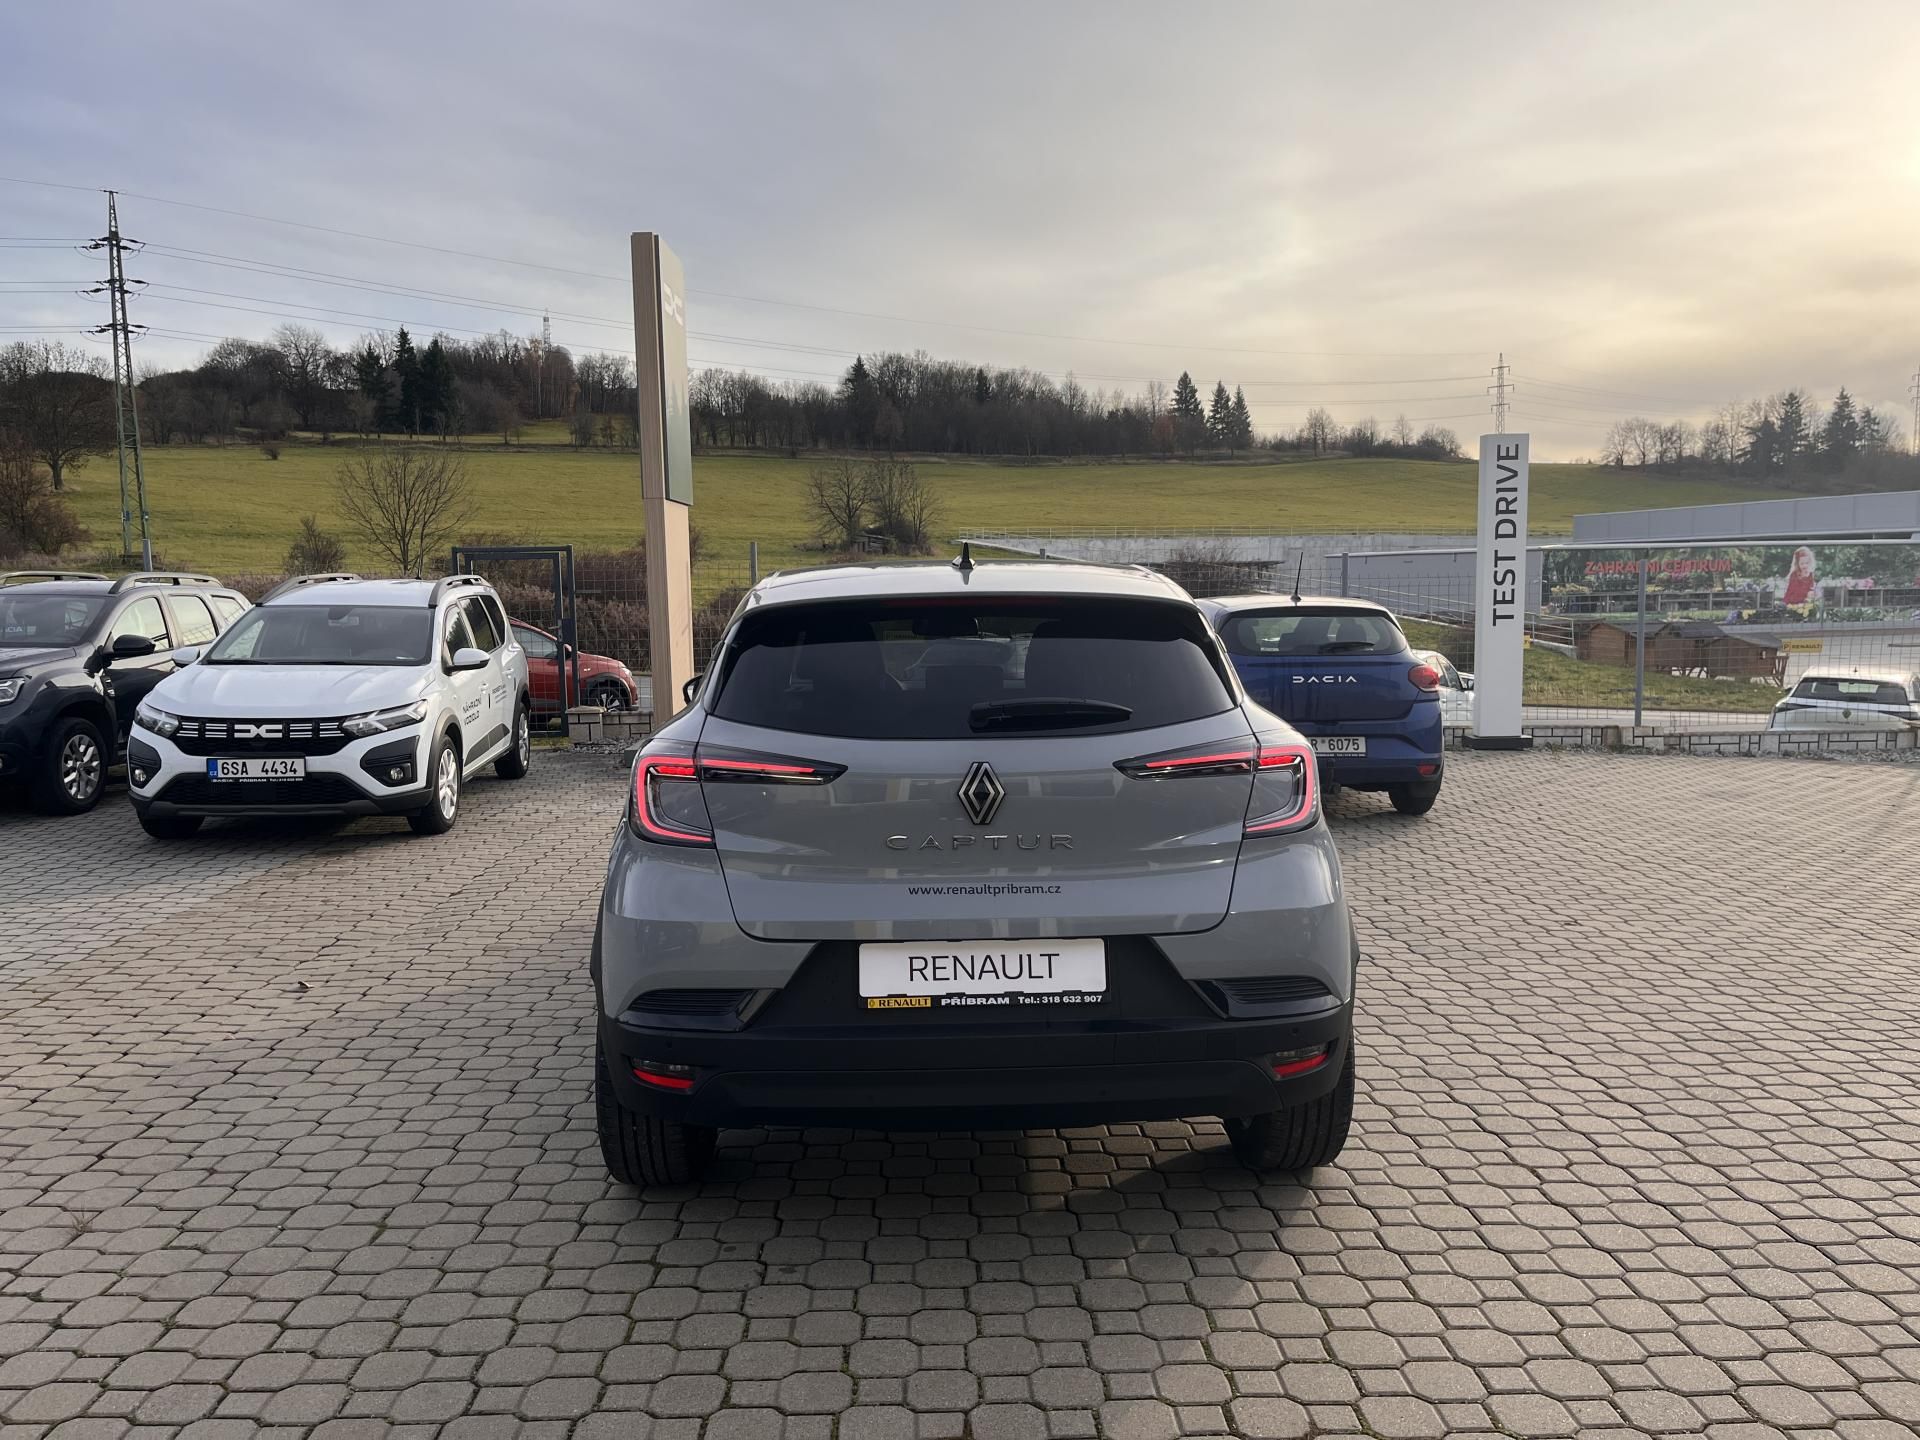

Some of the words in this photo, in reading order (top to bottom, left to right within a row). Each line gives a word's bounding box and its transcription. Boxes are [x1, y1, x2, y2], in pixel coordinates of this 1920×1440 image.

[1494, 443, 1519, 540] DRIVE
[1492, 549, 1516, 627] TEST
[1292, 675, 1357, 683] DACIA
[1328, 738, 1360, 751] 6075
[221, 761, 248, 775] 6SA
[261, 760, 297, 775] 4434
[886, 833, 1074, 850] CAPTUR
[908, 883, 1062, 897] www.renaultpribram.cz
[908, 953, 1060, 982] RENAULT
[878, 998, 930, 1008] RENAULT
[941, 996, 1010, 1006] PŘÍBRAM
[1017, 996, 1040, 1004] Tel.:
[1042, 995, 1061, 1004] 318
[1063, 995, 1081, 1004] 632
[1083, 995, 1103, 1004] 907
